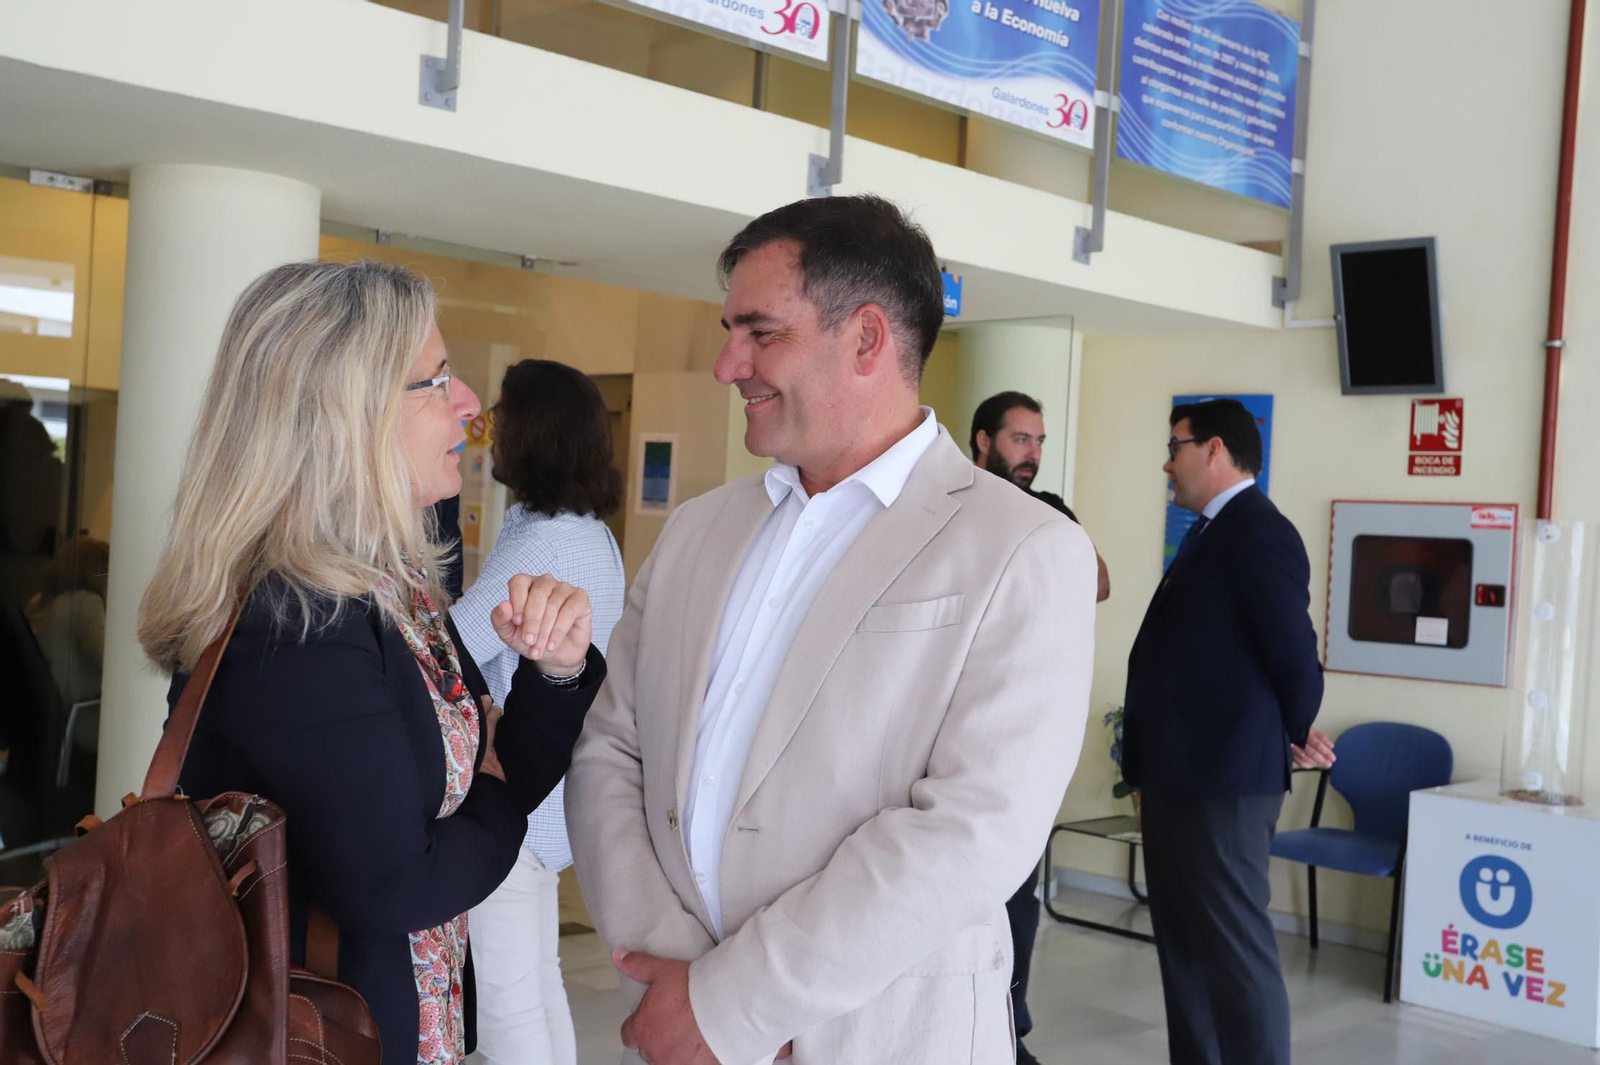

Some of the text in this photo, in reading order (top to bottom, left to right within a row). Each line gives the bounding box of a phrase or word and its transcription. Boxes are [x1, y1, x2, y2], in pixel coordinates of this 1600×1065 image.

[760, 0, 820, 39] 30
[971, 0, 1069, 48] a la Economía
[1046, 93, 1088, 130] 30
[1413, 466, 1456, 474] INCENDIO
[1415, 456, 1455, 465] BOCA DE
[1473, 834, 1519, 848] BENEFICIO
[1520, 842, 1532, 851] DE
[1441, 924, 1544, 974] ÉRASE
[1502, 971, 1566, 1008] VEZ
